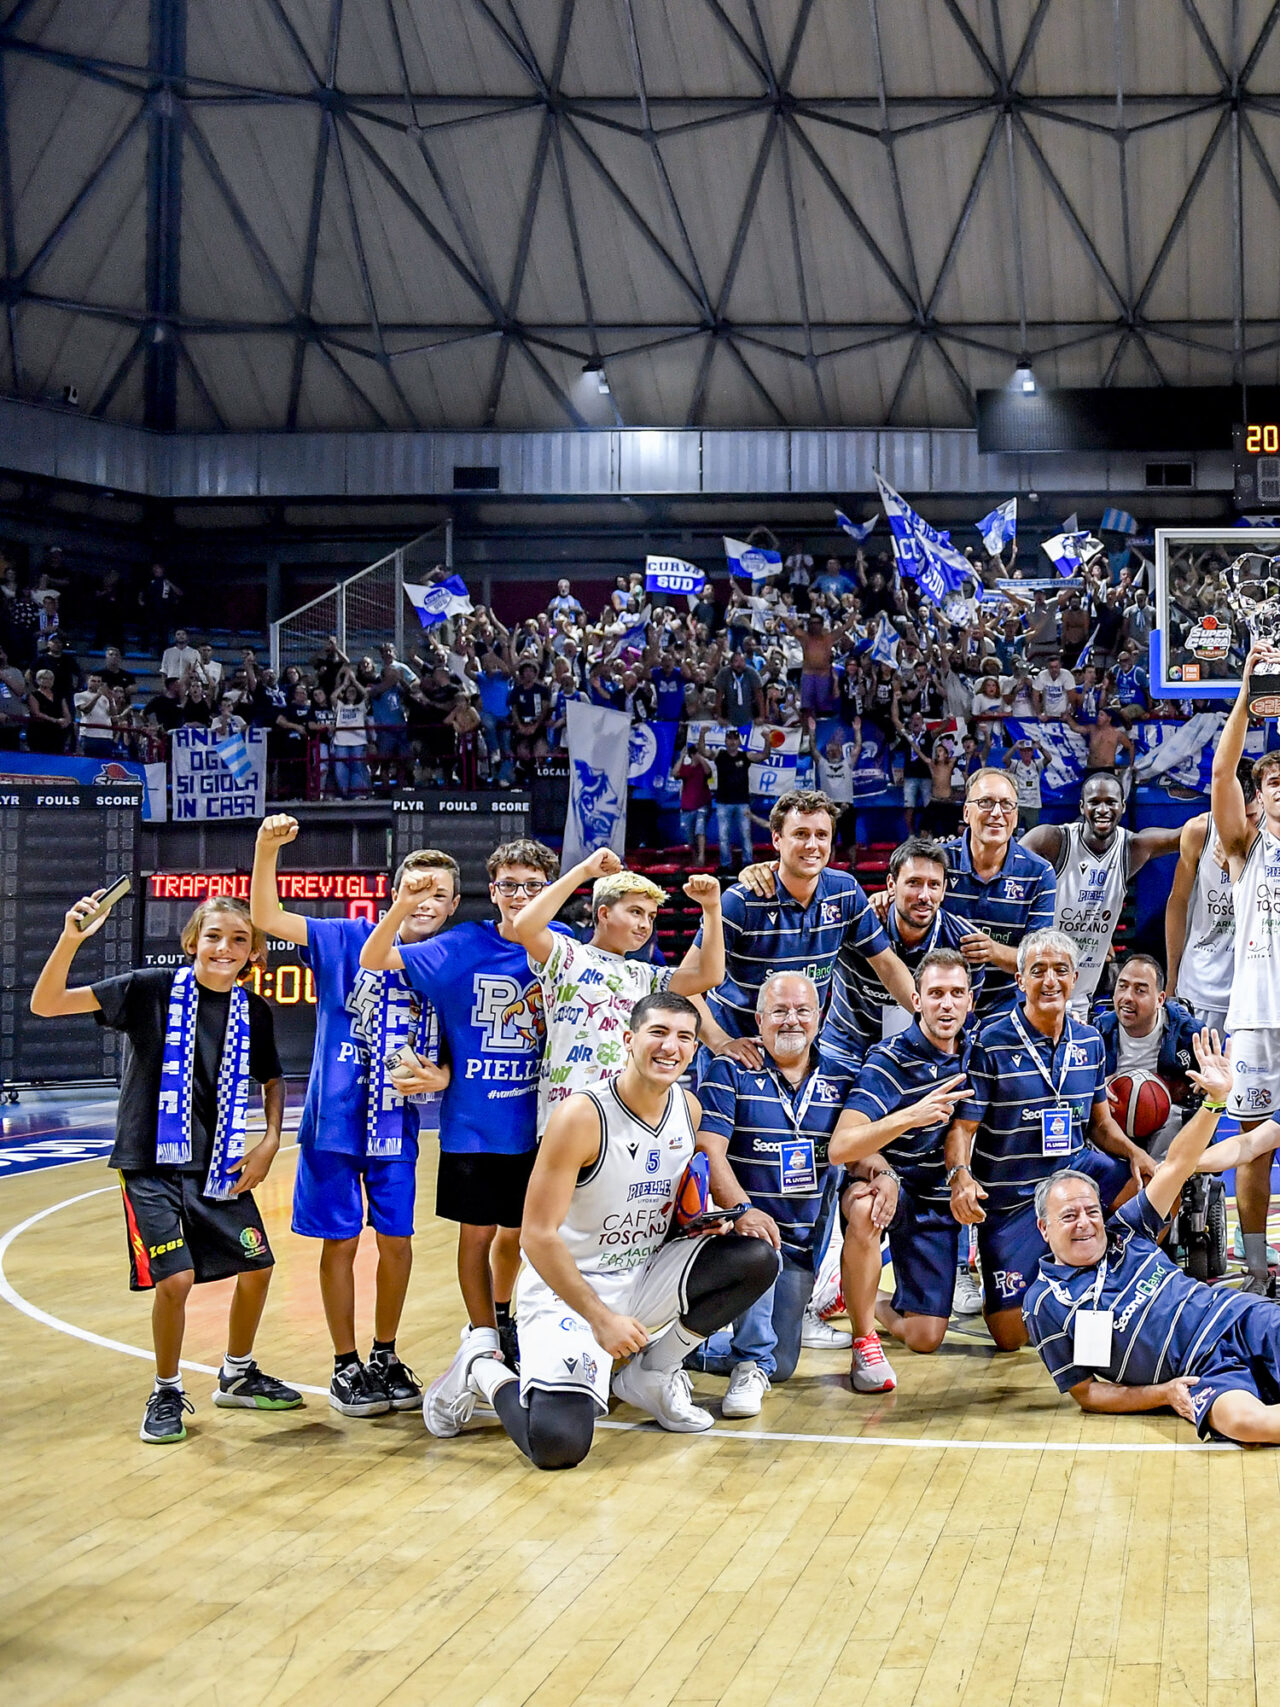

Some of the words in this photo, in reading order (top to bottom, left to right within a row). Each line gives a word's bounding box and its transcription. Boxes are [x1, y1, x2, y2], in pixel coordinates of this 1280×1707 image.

[656, 576, 694, 591] SUD
[1191, 628, 1230, 637] SUPER
[1186, 638, 1229, 648] COPPA
[177, 776, 194, 793] SI
[37, 796, 80, 806] FOULS
[96, 796, 139, 806] SCORE
[178, 799, 196, 818] IN
[206, 795, 256, 817] CASA
[393, 801, 424, 811] PLYR
[439, 802, 477, 811] FOULS
[491, 802, 529, 812] SCORE
[1088, 869, 1107, 886] 10
[151, 875, 250, 898] TRAPANI
[277, 876, 387, 898] TREVIGLI
[1207, 903, 1234, 915] TOSC
[1059, 921, 1109, 933] TOSCANO
[1072, 936, 1099, 945] MACIA
[145, 954, 185, 965] T.OUT
[577, 967, 604, 985] AIR
[862, 985, 898, 1000] Secon
[566, 1044, 593, 1062] AIR
[465, 1058, 541, 1080] PIELL
[752, 1139, 780, 1152] Seco
[646, 1149, 660, 1174] 5
[627, 1179, 671, 1202] PIELLE
[603, 1209, 662, 1231] CAFF
[150, 1238, 184, 1259] Zeus
[1114, 1292, 1148, 1333] Second
